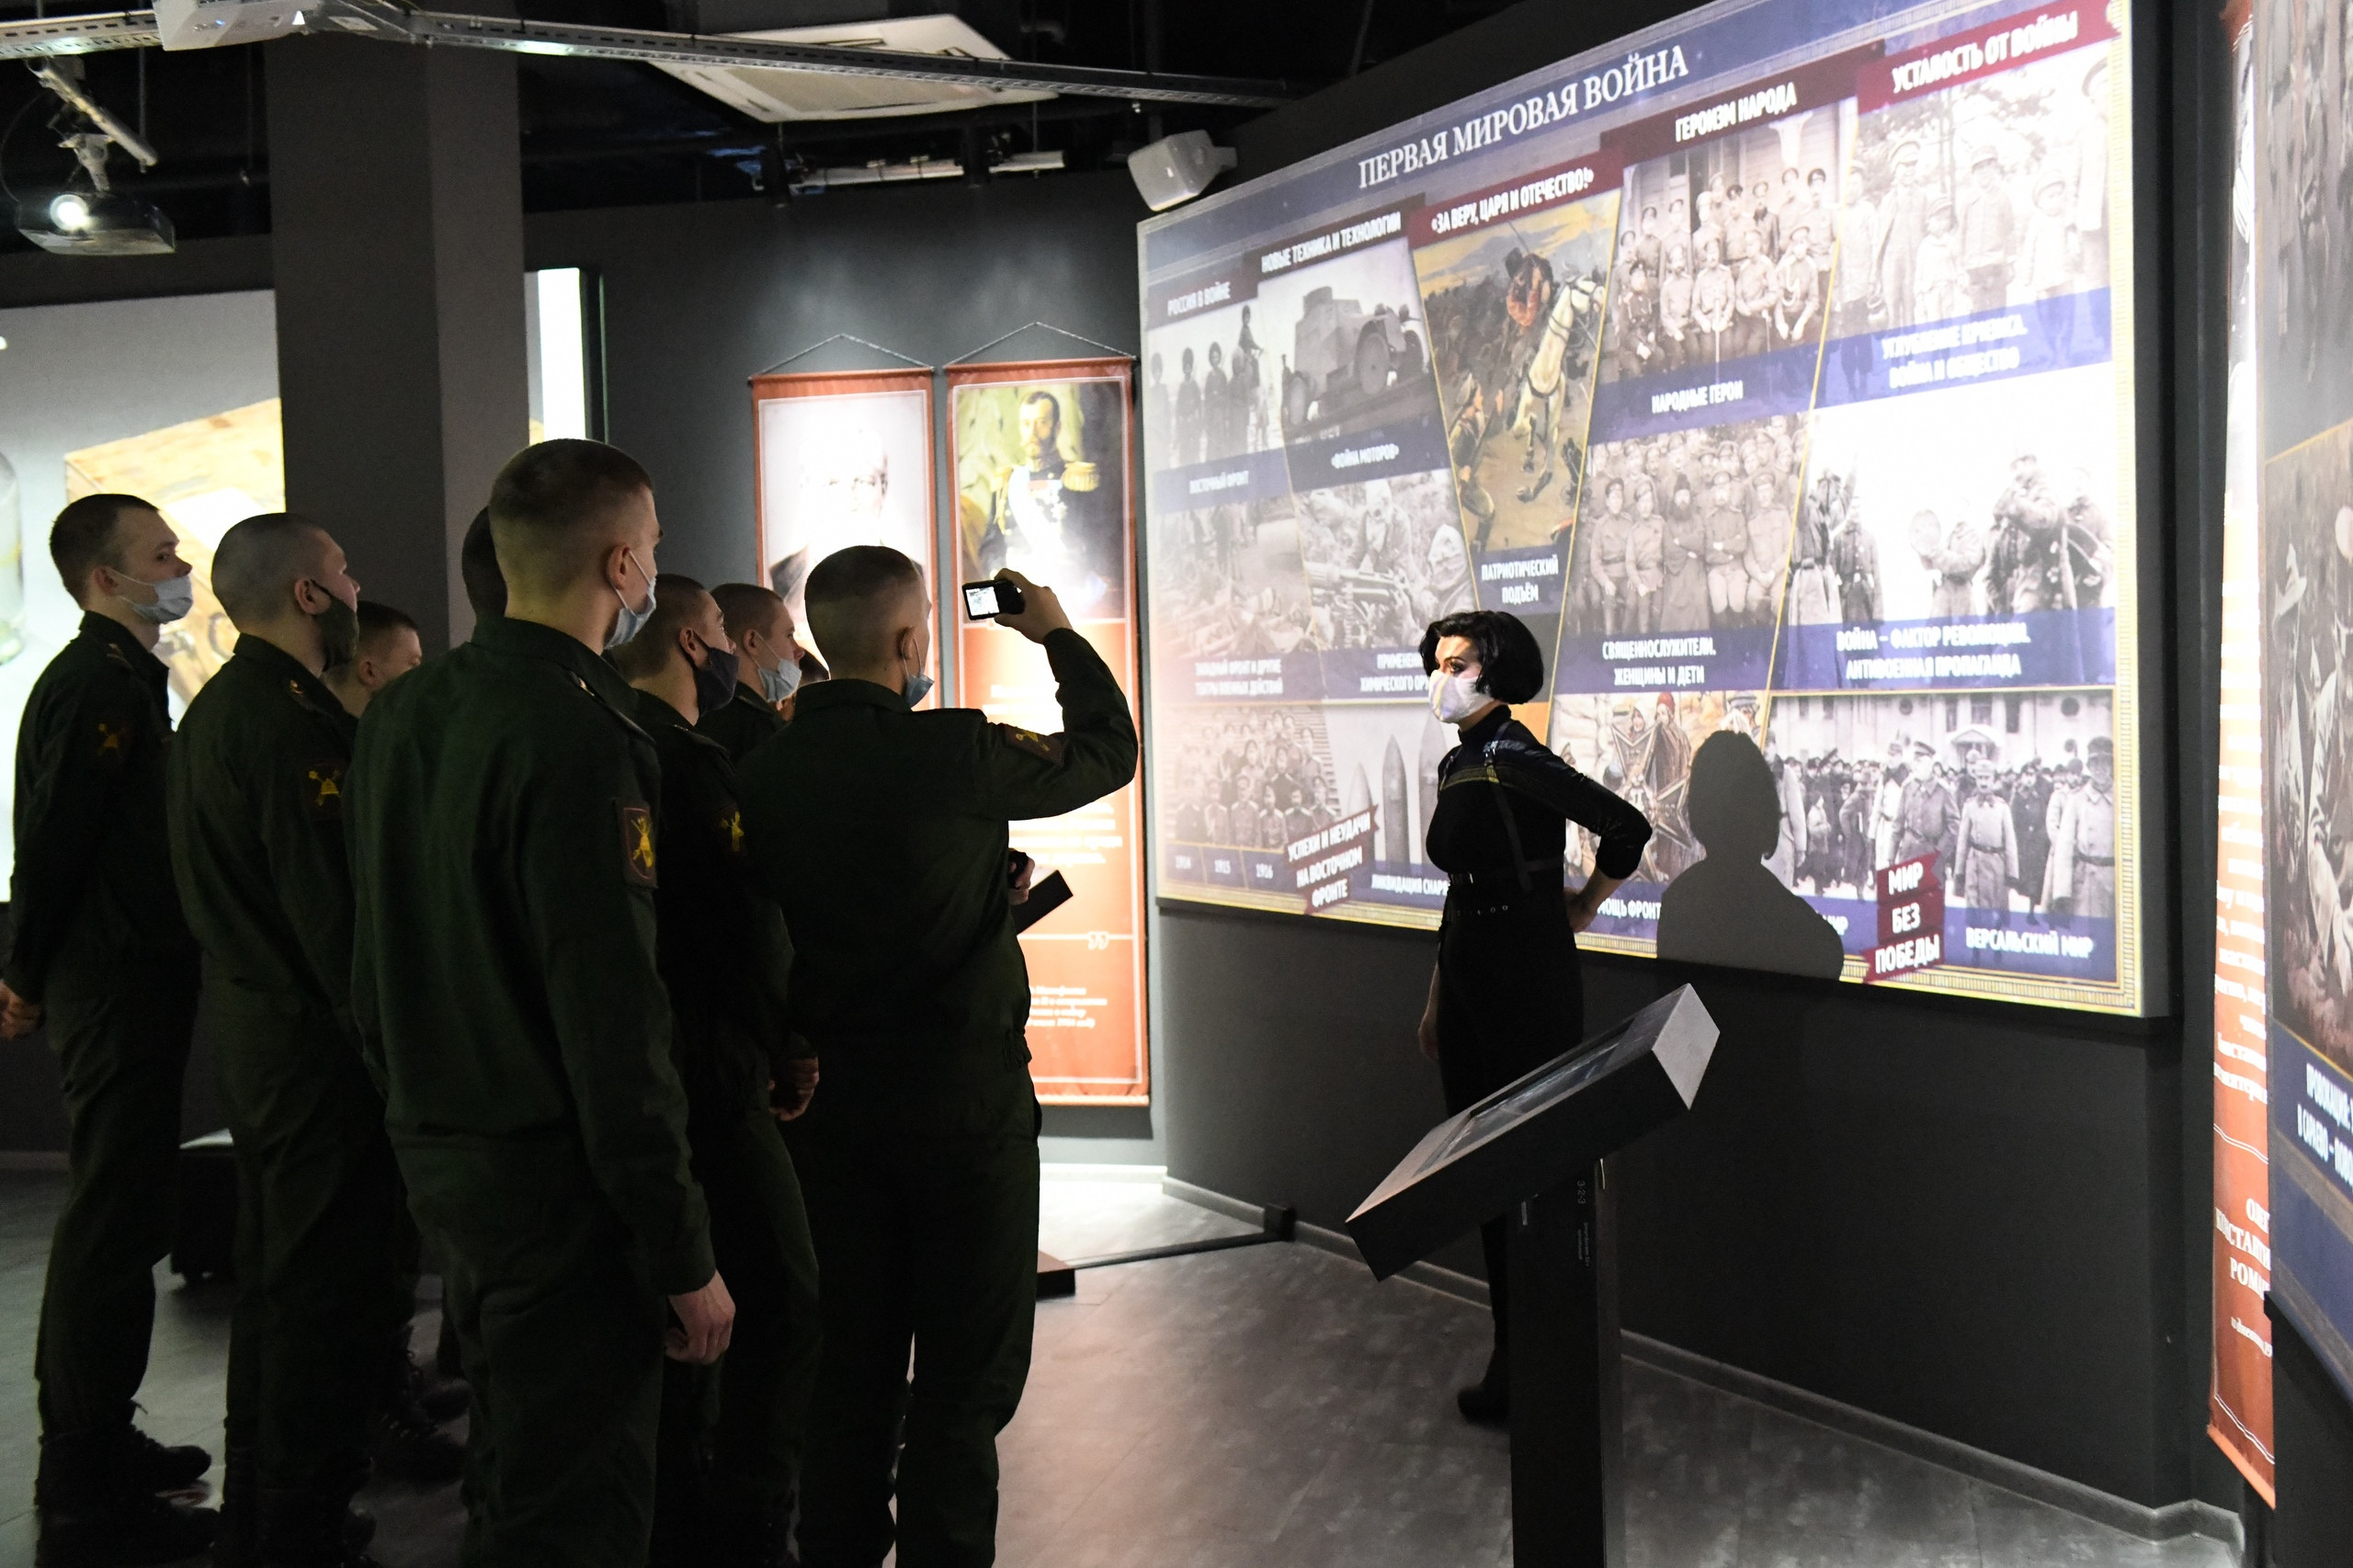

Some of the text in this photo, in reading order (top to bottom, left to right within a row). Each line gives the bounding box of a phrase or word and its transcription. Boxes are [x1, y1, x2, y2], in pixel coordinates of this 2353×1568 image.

[1892, 11, 2079, 94] УСТАЛОСТЬ ОТ ВОЙНЫ
[1358, 44, 1688, 189] ПЕРВАЯ МИРОВАЯ ВОЙНА
[1676, 81, 1796, 142] ГЕРОИЗМ НАРОДА
[1431, 165, 1595, 235] «ЗА ВЕРУ, ЦАРЯ И ОТЕЧЕСТВО!»
[1291, 234, 1332, 264] ТЕХНИКА
[1332, 231, 1340, 251] И
[1340, 211, 1402, 247] ТЕХНОЛОГИИ
[1933, 358, 1946, 381] И
[1652, 380, 1744, 415] НАРОДНЫЕ ГЕРОИ
[1481, 553, 1559, 582] ПАТРИОТИЧЕСКИЙ
[1501, 583, 1540, 605] ПОДЪЁМ
[1602, 636, 1717, 661] СВЯЩЕННОСЛУЖИТЕЛИ.
[1836, 627, 1878, 652] ВОЙНА
[1891, 625, 1940, 649] ФАКТОР
[1414, 675, 1429, 691] ОРУ
[1613, 664, 1705, 688] ЖЕНЩИНЫ И ДЕТИ
[1846, 653, 2021, 683] АНТИВОЕННАЯ ПРОПАГАНДА
[1288, 811, 1370, 863] УСПЕХИ И НЕУДАЧИ
[1308, 846, 1363, 882] ВОСТОЧНОМ
[1887, 861, 1924, 896] МИР
[1423, 878, 1449, 896] СНАРЯ
[1628, 899, 1662, 920] ФРОНТ
[1892, 902, 1921, 932] БЕЗ
[1874, 934, 1940, 976] ПОБЕДЫ
[1965, 926, 2094, 960] ВЕРСАЛЬСКИЙ МИР
[2215, 1207, 2271, 1271] КОНСТАНТИ
